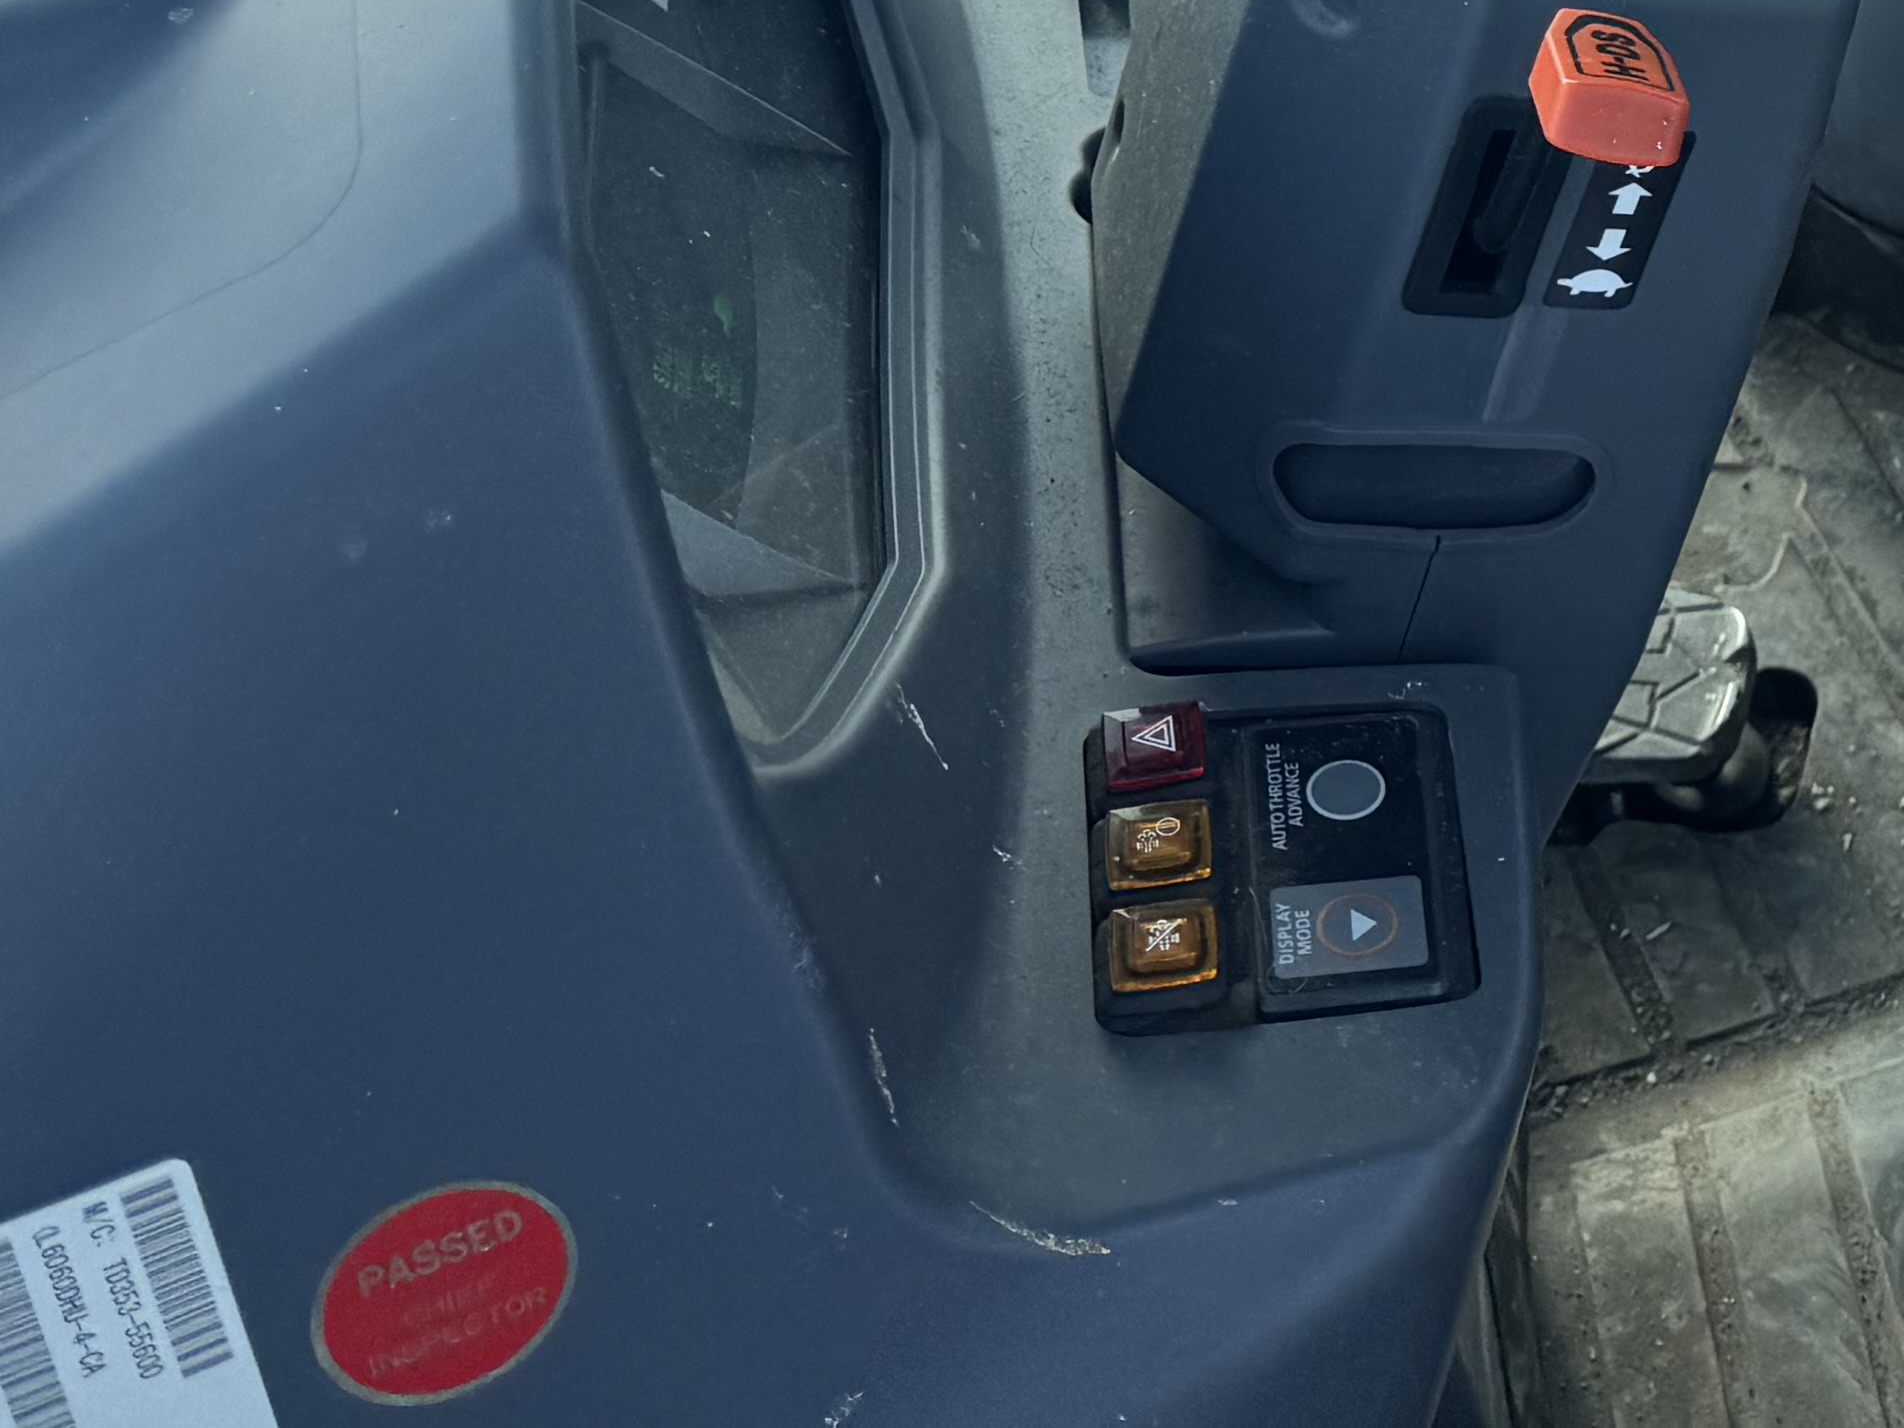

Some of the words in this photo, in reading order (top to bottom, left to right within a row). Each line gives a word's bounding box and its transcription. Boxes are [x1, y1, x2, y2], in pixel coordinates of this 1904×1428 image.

[1265, 743, 1285, 811] THROTTLE
[1284, 762, 1303, 827] ADVANCE
[1271, 812, 1288, 850] AUTO
[1276, 903, 1294, 965] DISPLAY
[1295, 909, 1312, 955] MODE
[357, 1210, 522, 1297] PASSED
